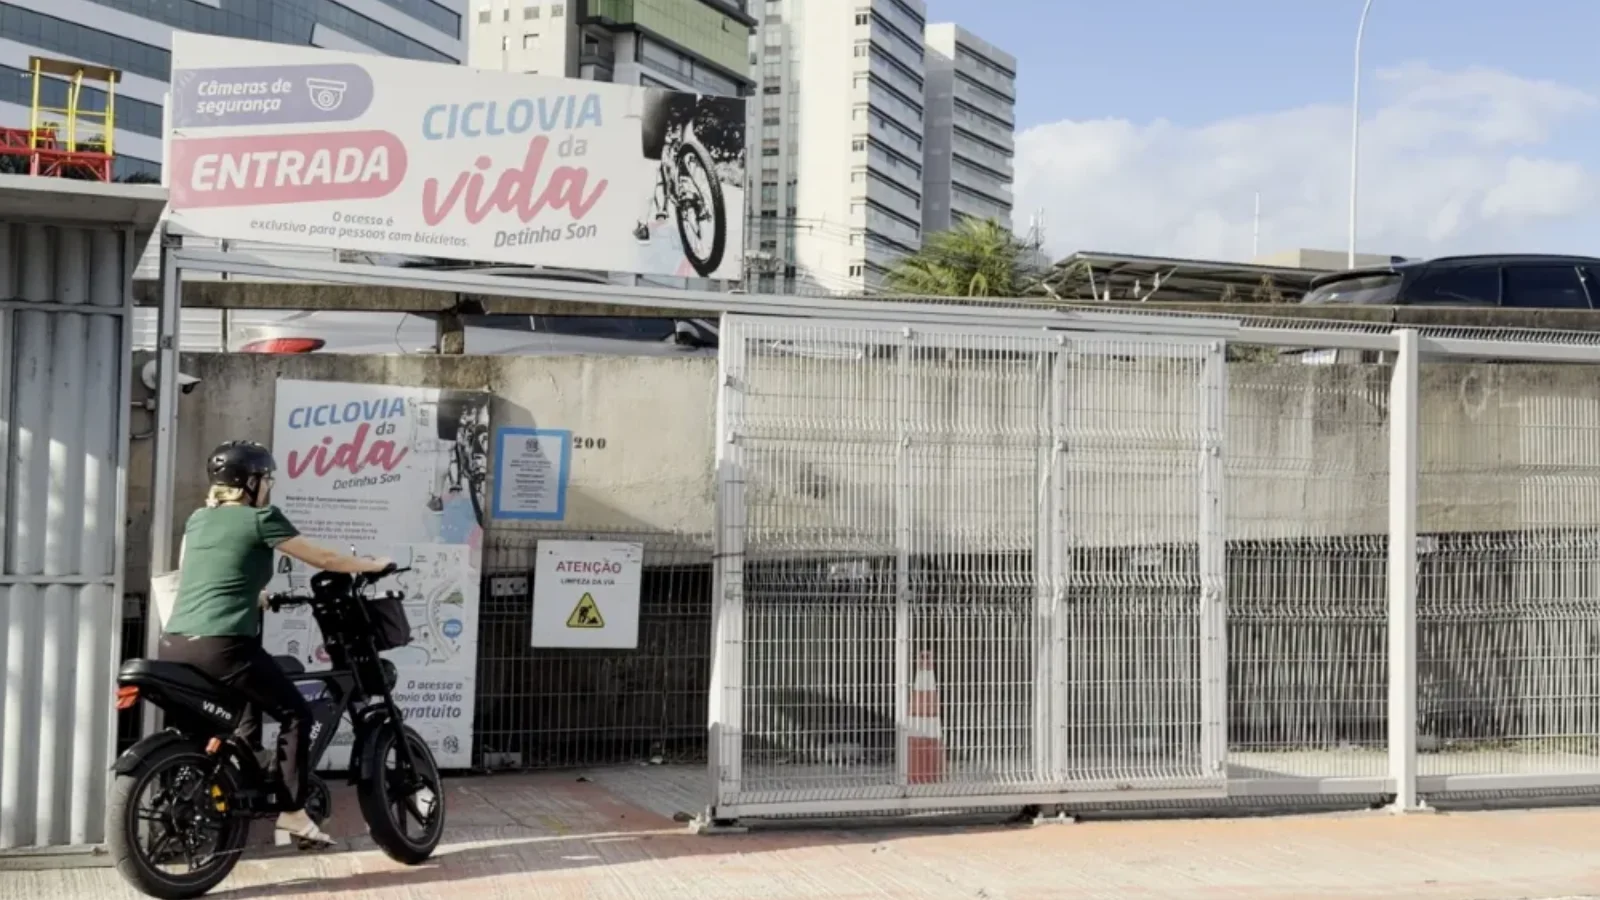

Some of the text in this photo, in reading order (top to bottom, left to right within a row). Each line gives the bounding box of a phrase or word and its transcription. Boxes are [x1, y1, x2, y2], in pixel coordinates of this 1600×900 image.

[198, 78, 292, 96] Câmeras de
[196, 98, 281, 116] segurança
[422, 93, 603, 140] CICLOVIA
[557, 135, 588, 157] da
[191, 145, 390, 191] ENTRADA
[422, 135, 609, 226] vida
[333, 211, 394, 227] O acesso é
[249, 219, 307, 233] exclusivo
[308, 223, 335, 236] para
[338, 225, 386, 240] pessoas
[388, 231, 413, 242] com
[493, 221, 597, 248] Detinha Son
[287, 397, 406, 429] CICLOVIA
[375, 421, 396, 436] da
[287, 422, 409, 479] vida
[573, 436, 606, 449] 200
[332, 473, 401, 490] Detinha Son
[555, 558, 622, 574] ATENÇÃO
[407, 680, 415, 690] O
[439, 692, 462, 702] Vida
[215, 706, 232, 720] Pro
[402, 704, 462, 720] gratuito
